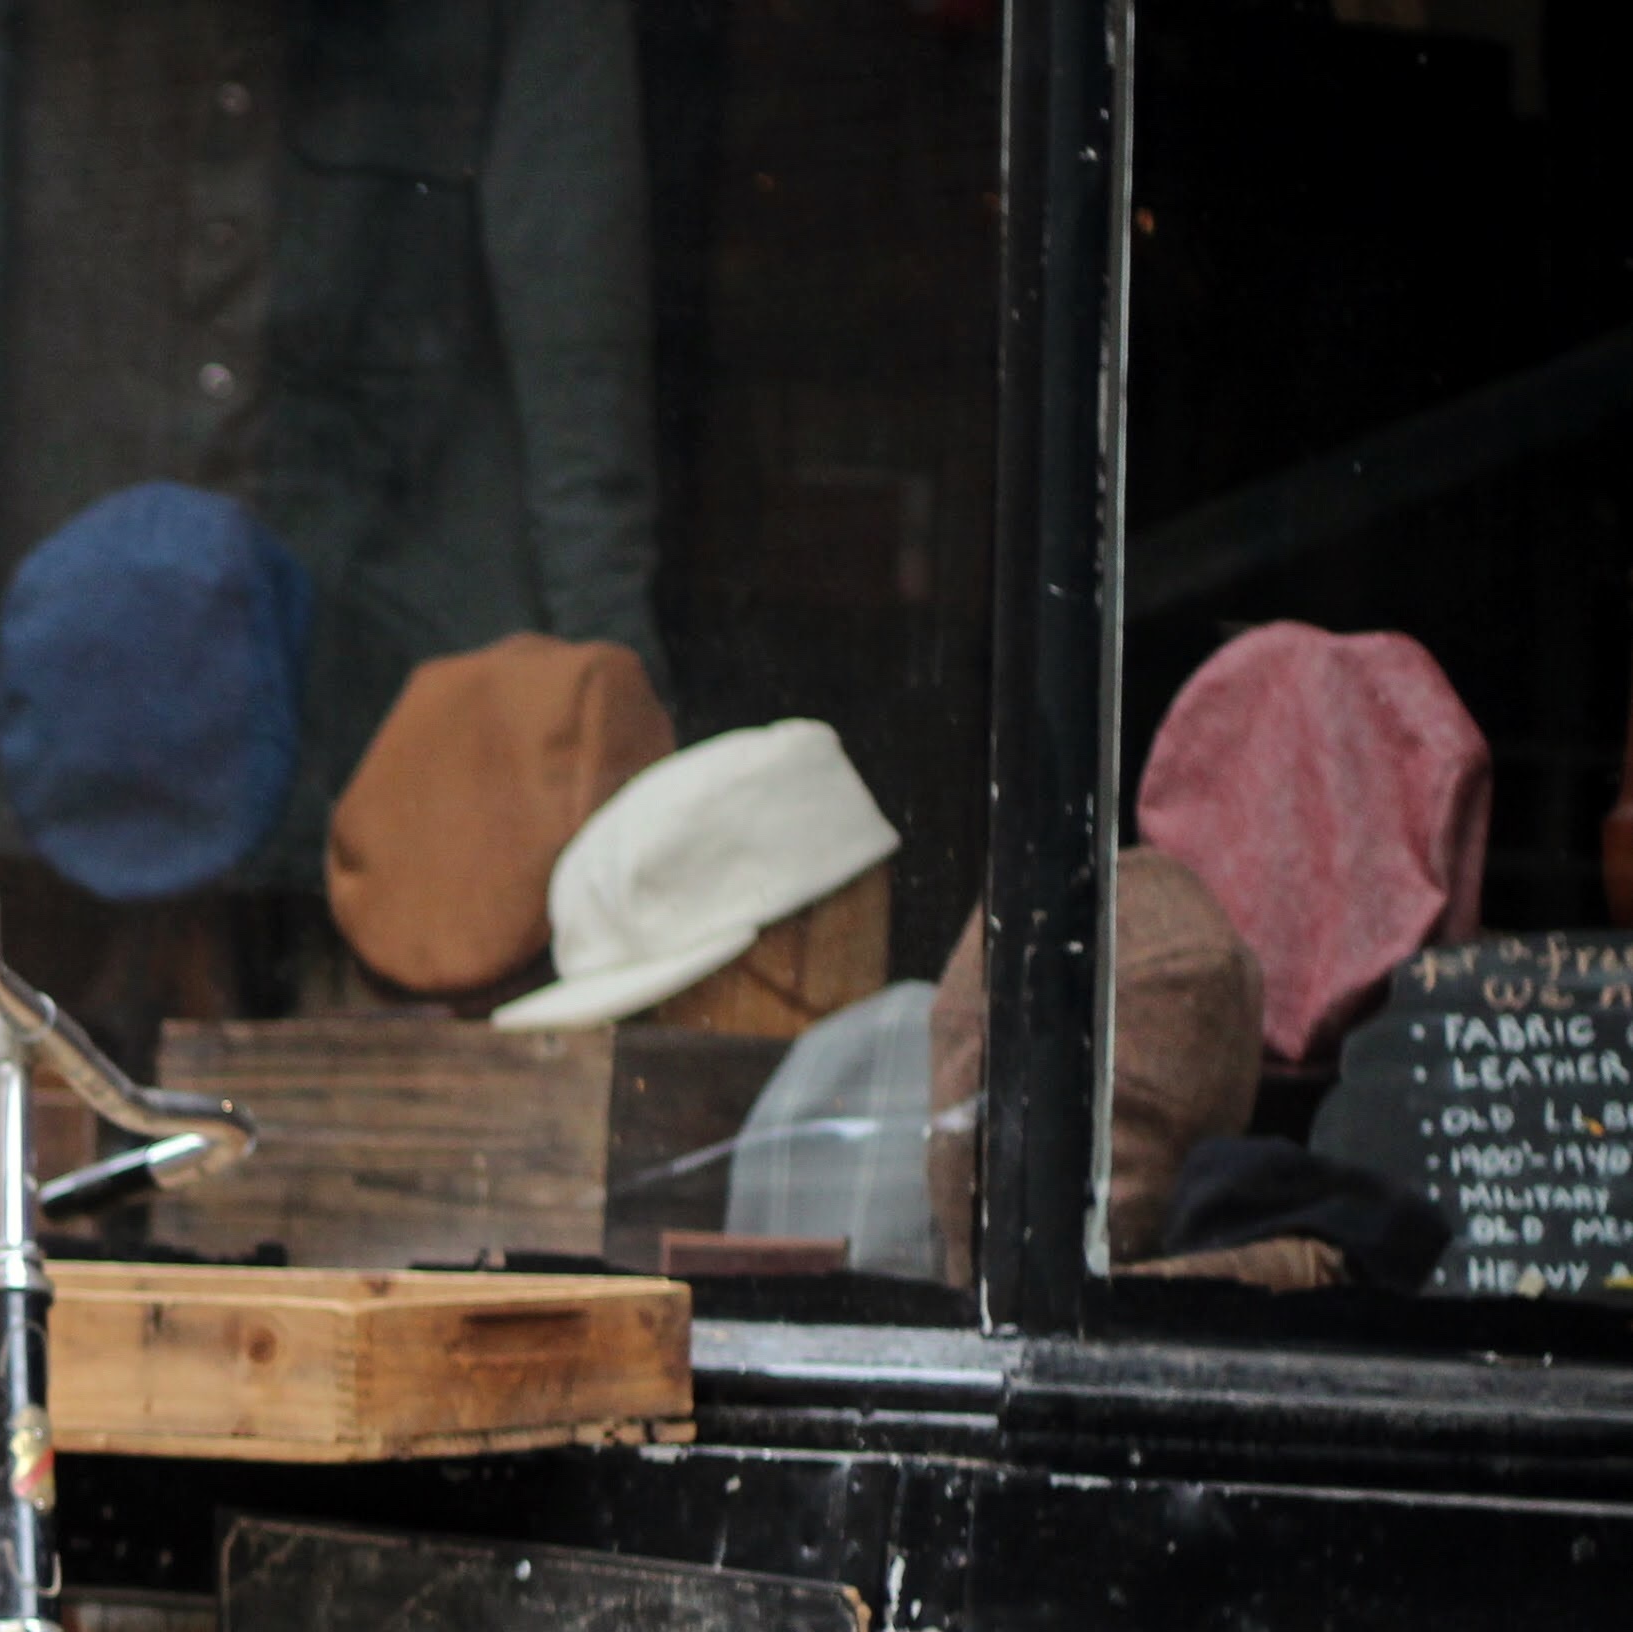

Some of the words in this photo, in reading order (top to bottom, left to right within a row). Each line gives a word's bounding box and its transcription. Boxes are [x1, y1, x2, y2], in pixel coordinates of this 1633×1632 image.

[1443, 1012, 1597, 1052] FABRIC
[1452, 1049, 1631, 1091] LEATHER
[1440, 1102, 1515, 1137] OLD
[1458, 1180, 1610, 1214] MILITARY
[1468, 1213, 1545, 1246] OLD
